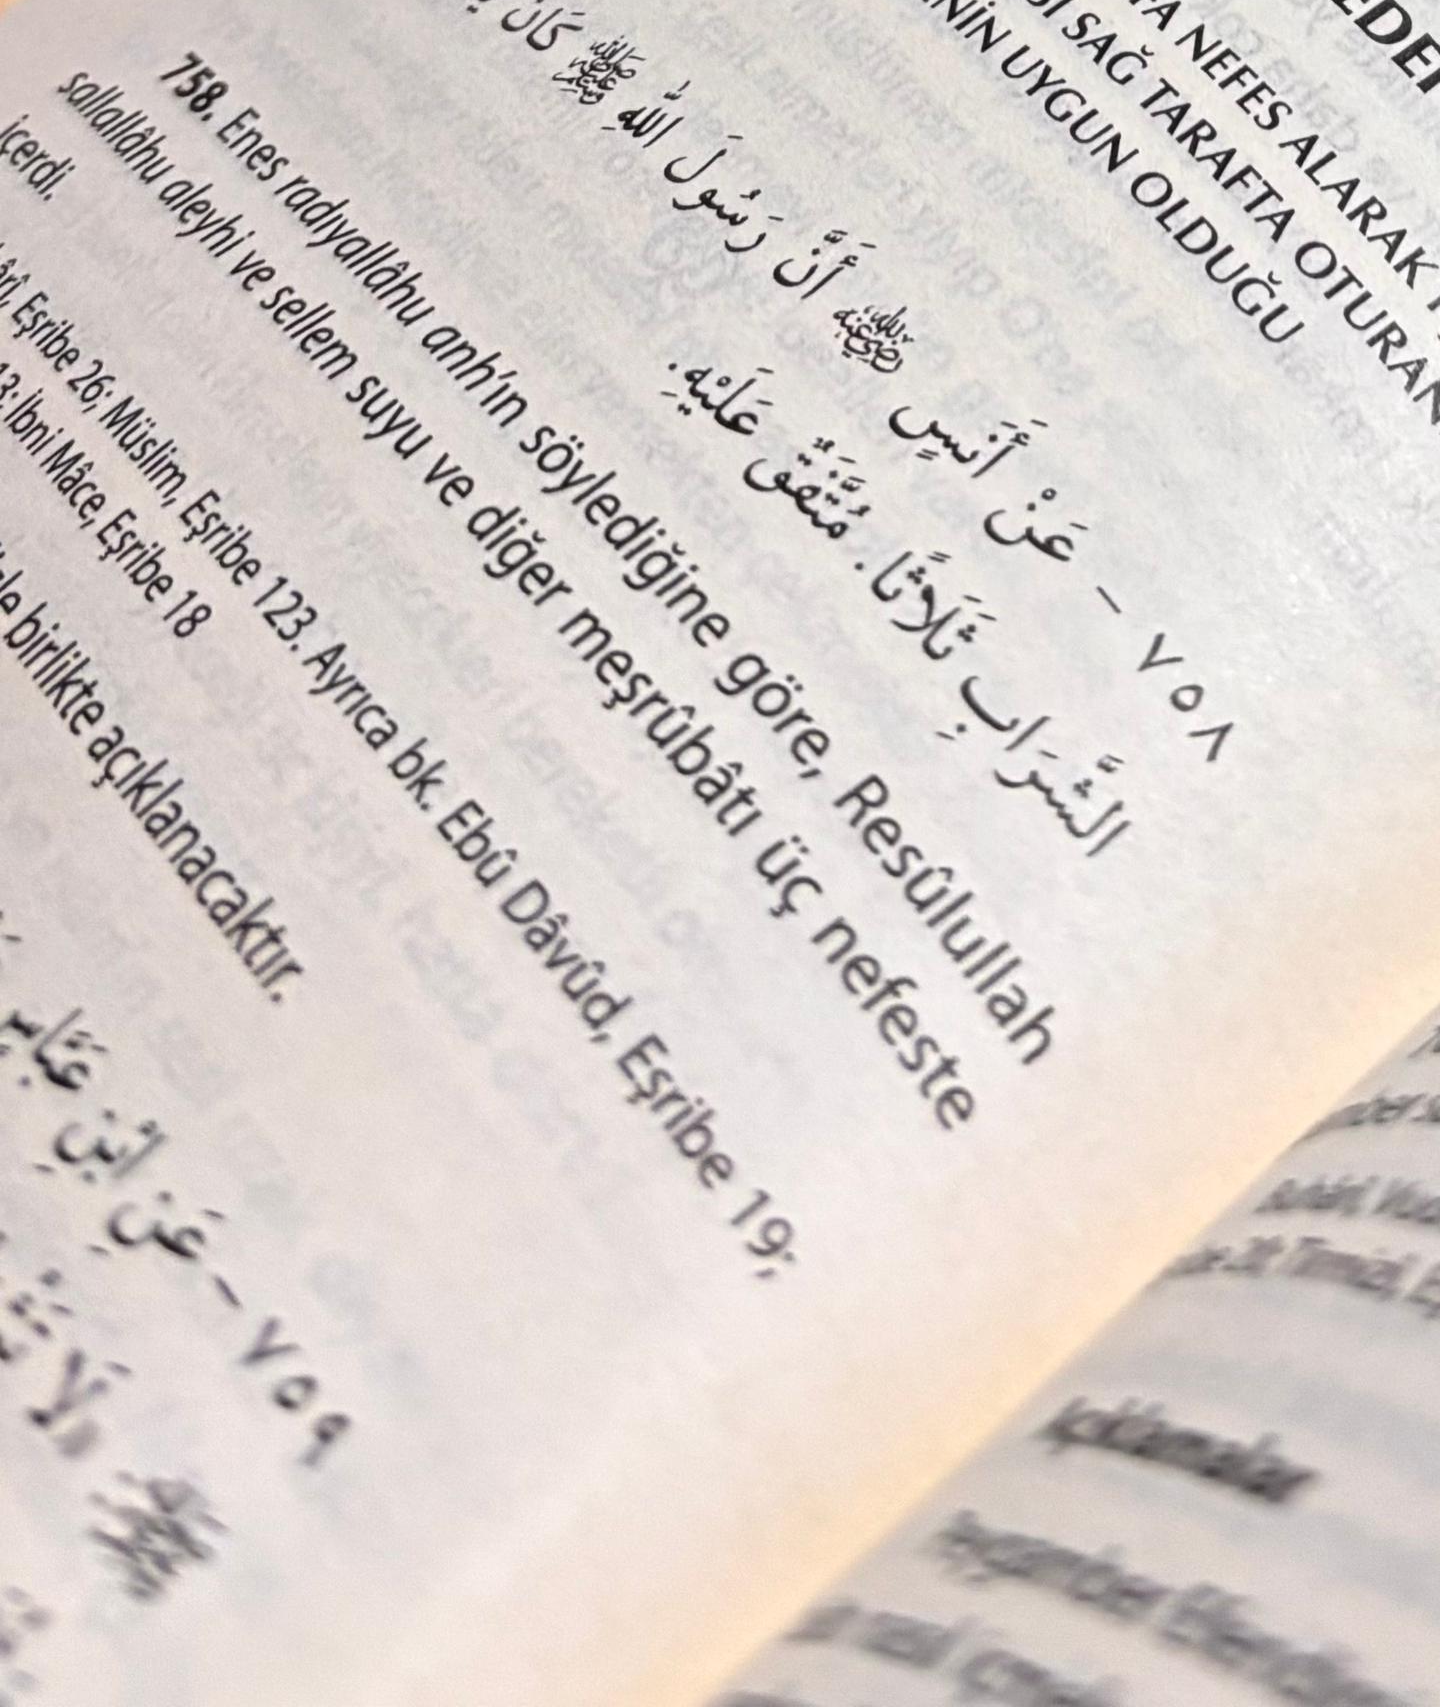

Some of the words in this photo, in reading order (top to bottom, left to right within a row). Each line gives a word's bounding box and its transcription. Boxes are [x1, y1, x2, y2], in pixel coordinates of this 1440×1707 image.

[1001, 45, 1139, 173] UYGUN
[1130, 171, 1305, 343] OLDUĞU
[1062, 12, 1155, 85] SAĞ
[1140, 78, 1295, 243] TARAFTA
[1176, 24, 1292, 130] NEFES
[1279, 134, 1439, 289] ALARAK
[40, 439, 106, 529] Mâce,
[97, 508, 173, 602] Eşribe
[162, 591, 212, 638] 18
[58, 72, 175, 184] sallallâhu
[159, 180, 255, 258] aleyhi
[230, 250, 276, 291] ve
[260, 286, 358, 380] sellem
[346, 375, 432, 461] suyu
[424, 453, 475, 506] ve
[467, 505, 573, 609] diğer
[559, 607, 764, 837] meşrûbâtı
[755, 836, 822, 918] üç
[810, 916, 976, 1130] nefeste
[159, 53, 229, 122] 758.
[217, 107, 289, 181] Enes
[274, 175, 434, 327] radıyallâhu
[520, 424, 730, 649] söylediğine
[714, 651, 831, 779] göre,
[833, 774, 1056, 1066] Resûlullah
[3, 603, 104, 737] birlikte
[87, 725, 302, 1004] açıklanacaktır.
[12, 291, 80, 372] Eşribe
[67, 359, 116, 413] 26;
[99, 395, 187, 508] Müslim,
[179, 489, 262, 585] Eşribe
[253, 576, 317, 651] 123.
[302, 643, 398, 749] Ayrıca
[387, 737, 447, 811] bk.
[436, 799, 518, 892] Ebû
[500, 878, 634, 1044] Dâvûd,
[616, 1032, 735, 1188] Eşribe
[729, 1188, 797, 1280] 19;
